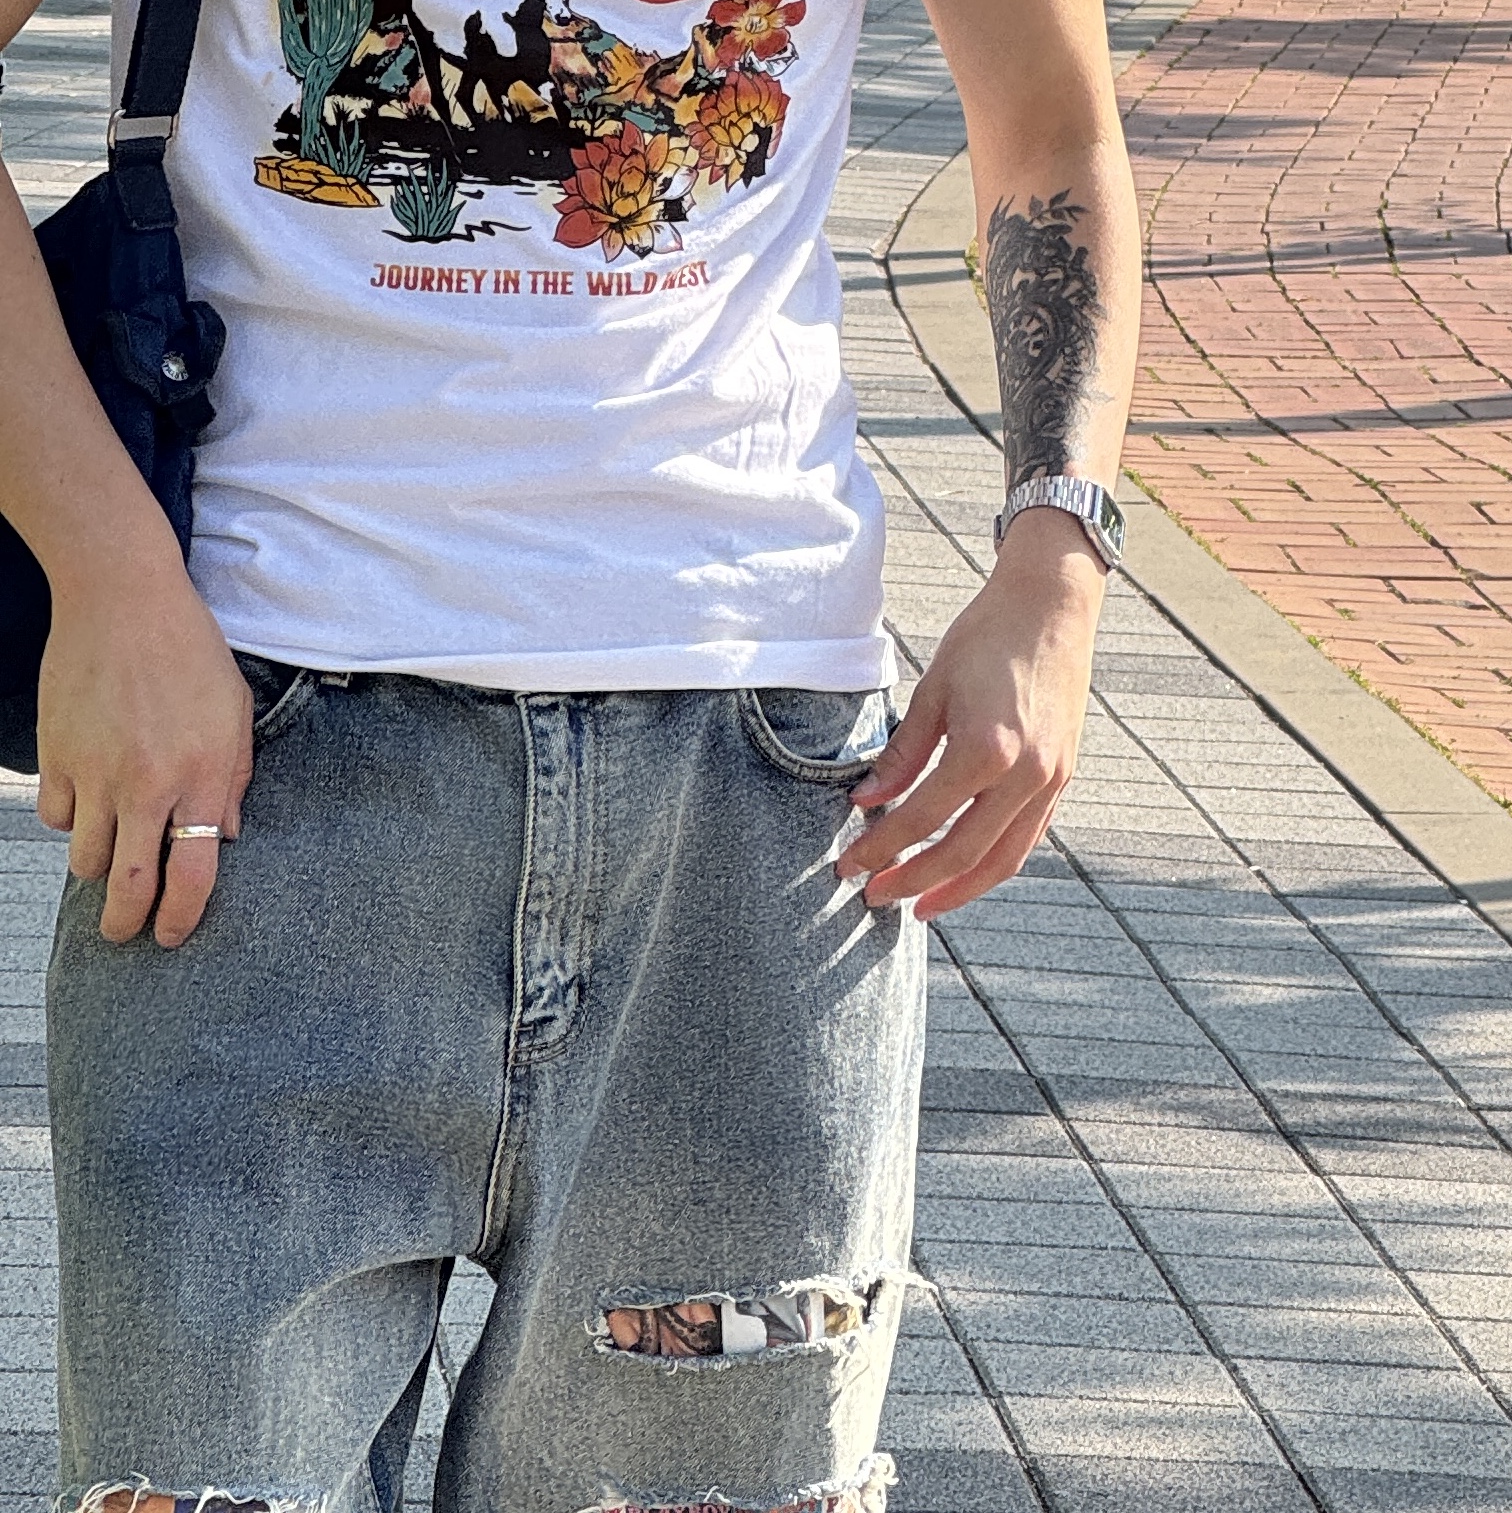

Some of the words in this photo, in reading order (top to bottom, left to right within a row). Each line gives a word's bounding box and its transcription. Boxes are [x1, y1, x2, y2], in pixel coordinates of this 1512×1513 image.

[370, 263, 488, 294] JOURNEY
[493, 269, 521, 294] IN
[527, 270, 574, 295] THE
[586, 270, 658, 296] WILD
[660, 260, 711, 291] WEST
